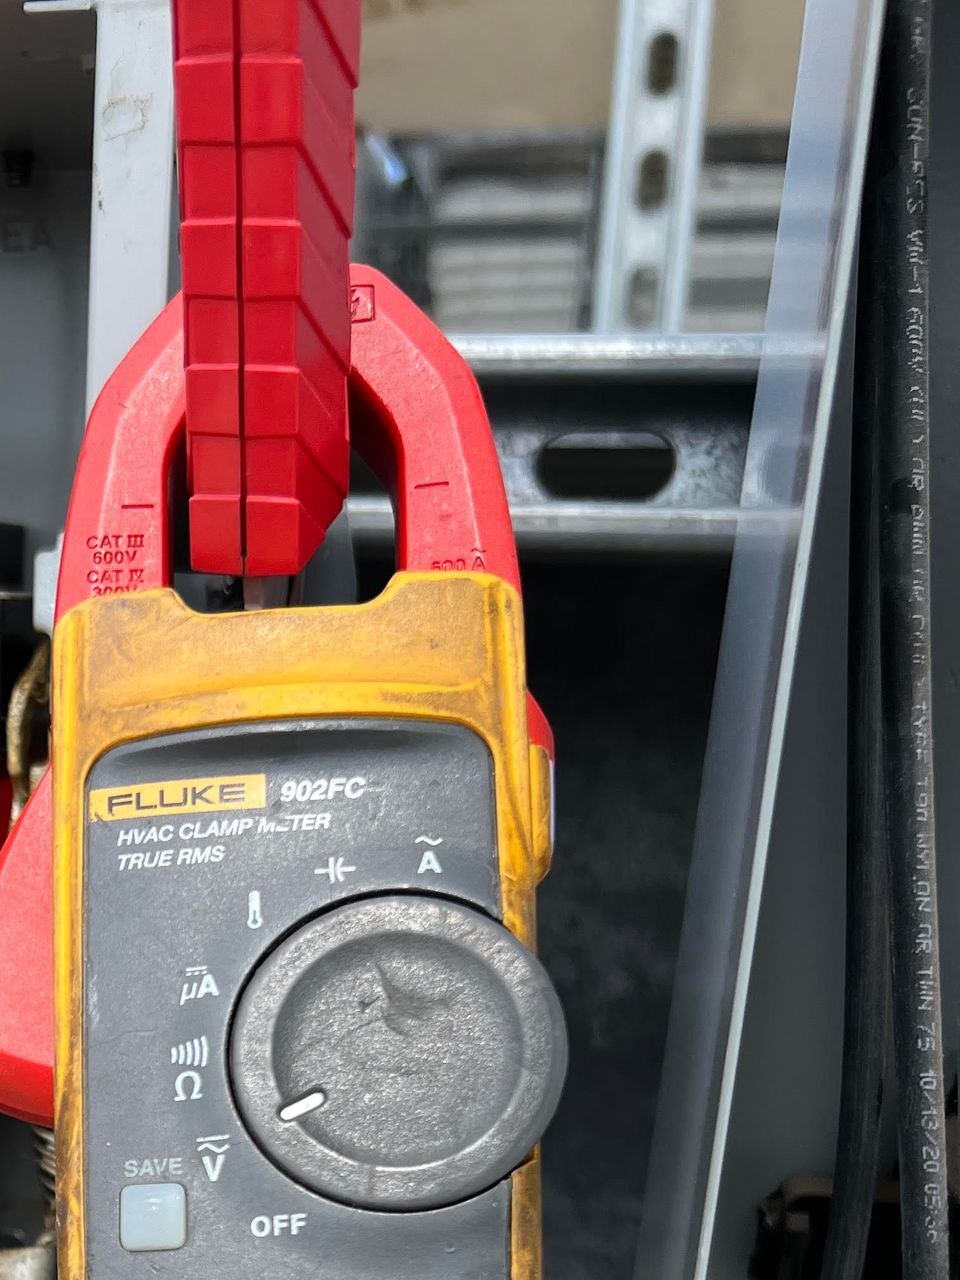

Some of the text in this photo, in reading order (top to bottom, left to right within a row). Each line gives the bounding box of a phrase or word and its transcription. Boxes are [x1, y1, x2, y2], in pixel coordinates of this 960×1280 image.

[86, 535, 122, 549] CAT
[93, 550, 137, 564] 600V
[86, 570, 123, 583] CAT
[107, 777, 367, 814] FLUKE 902FC
[117, 828, 173, 847] HVAC
[178, 819, 254, 839] CLAMP
[117, 845, 226, 870] TRUE RMS
[918, 1069, 939, 1172] 10/13/20
[124, 1158, 184, 1178] SAVE
[250, 1214, 308, 1238] OFF
